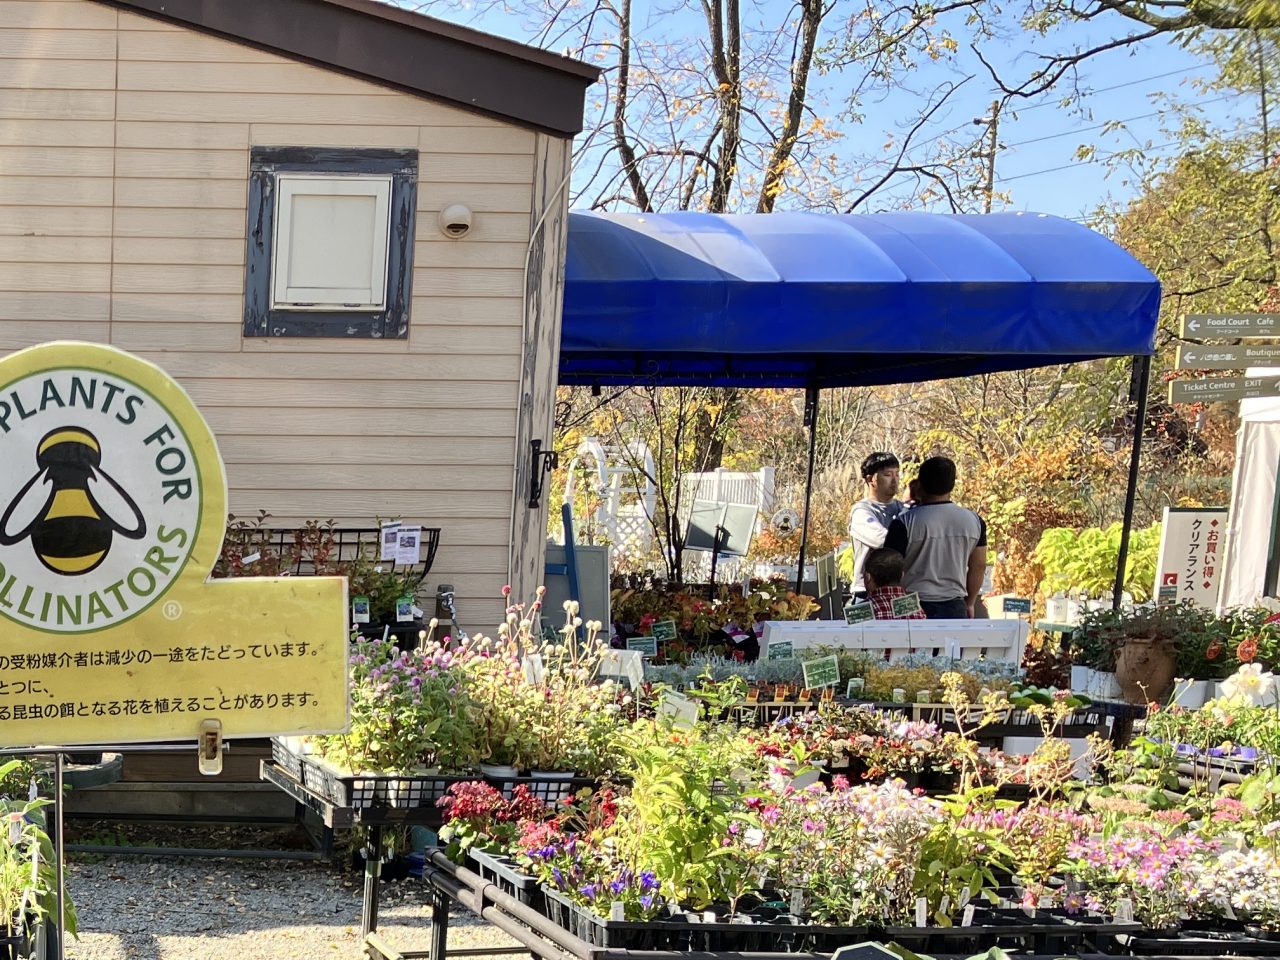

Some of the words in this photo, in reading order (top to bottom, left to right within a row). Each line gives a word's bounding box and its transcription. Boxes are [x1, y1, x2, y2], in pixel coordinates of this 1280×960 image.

[1207, 318, 1227, 326] Food
[1227, 318, 1250, 326] Court
[1256, 317, 1275, 325] Cafe
[1183, 383, 1208, 391] Ticket
[1208, 381, 1236, 389] Centre
[1244, 379, 1263, 387] EXIT
[143, 424, 192, 504] FOR
[1184, 519, 1202, 591] クリアランス
